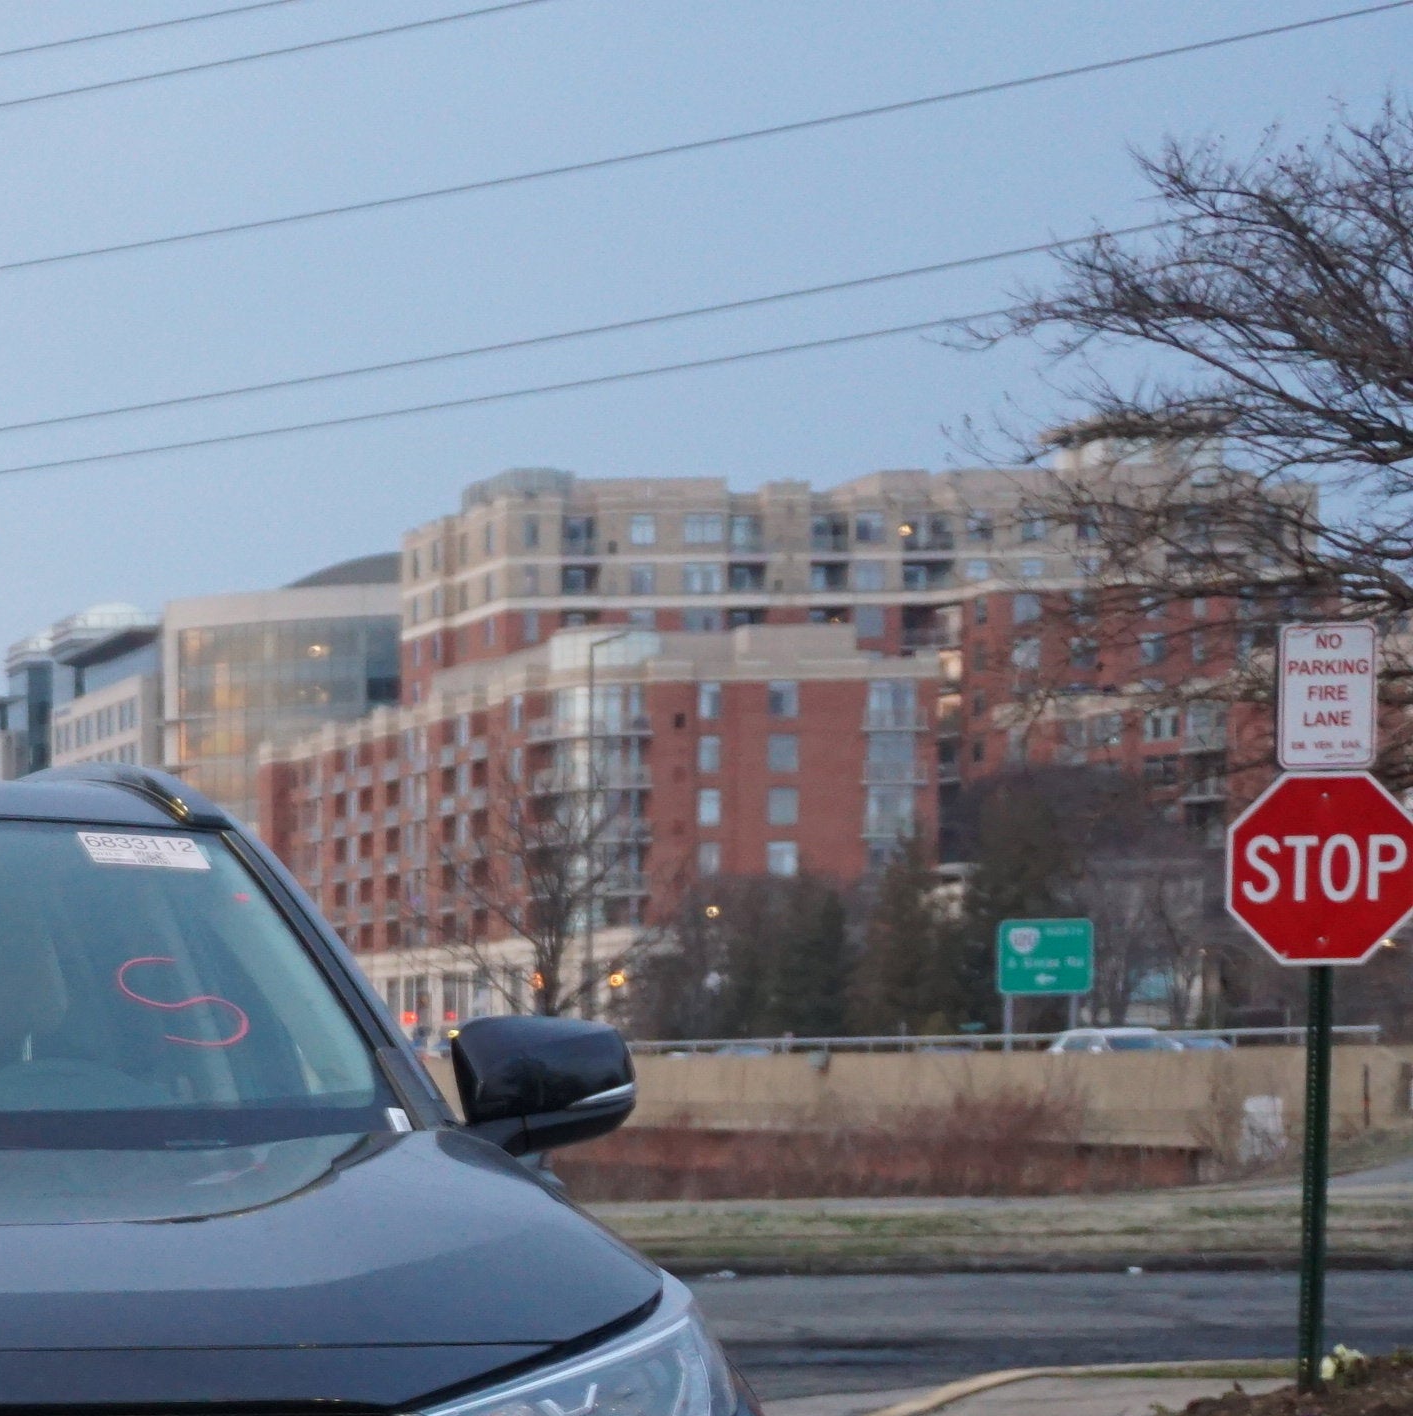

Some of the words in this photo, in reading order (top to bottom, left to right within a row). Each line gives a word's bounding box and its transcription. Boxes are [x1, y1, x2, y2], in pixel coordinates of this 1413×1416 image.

[1314, 633, 1343, 649] NO
[1287, 659, 1370, 675] PARKING
[1307, 685, 1348, 701] FIRE
[1303, 710, 1352, 727] LANE
[84, 834, 198, 853] 6833112
[1241, 832, 1408, 904] STOP
